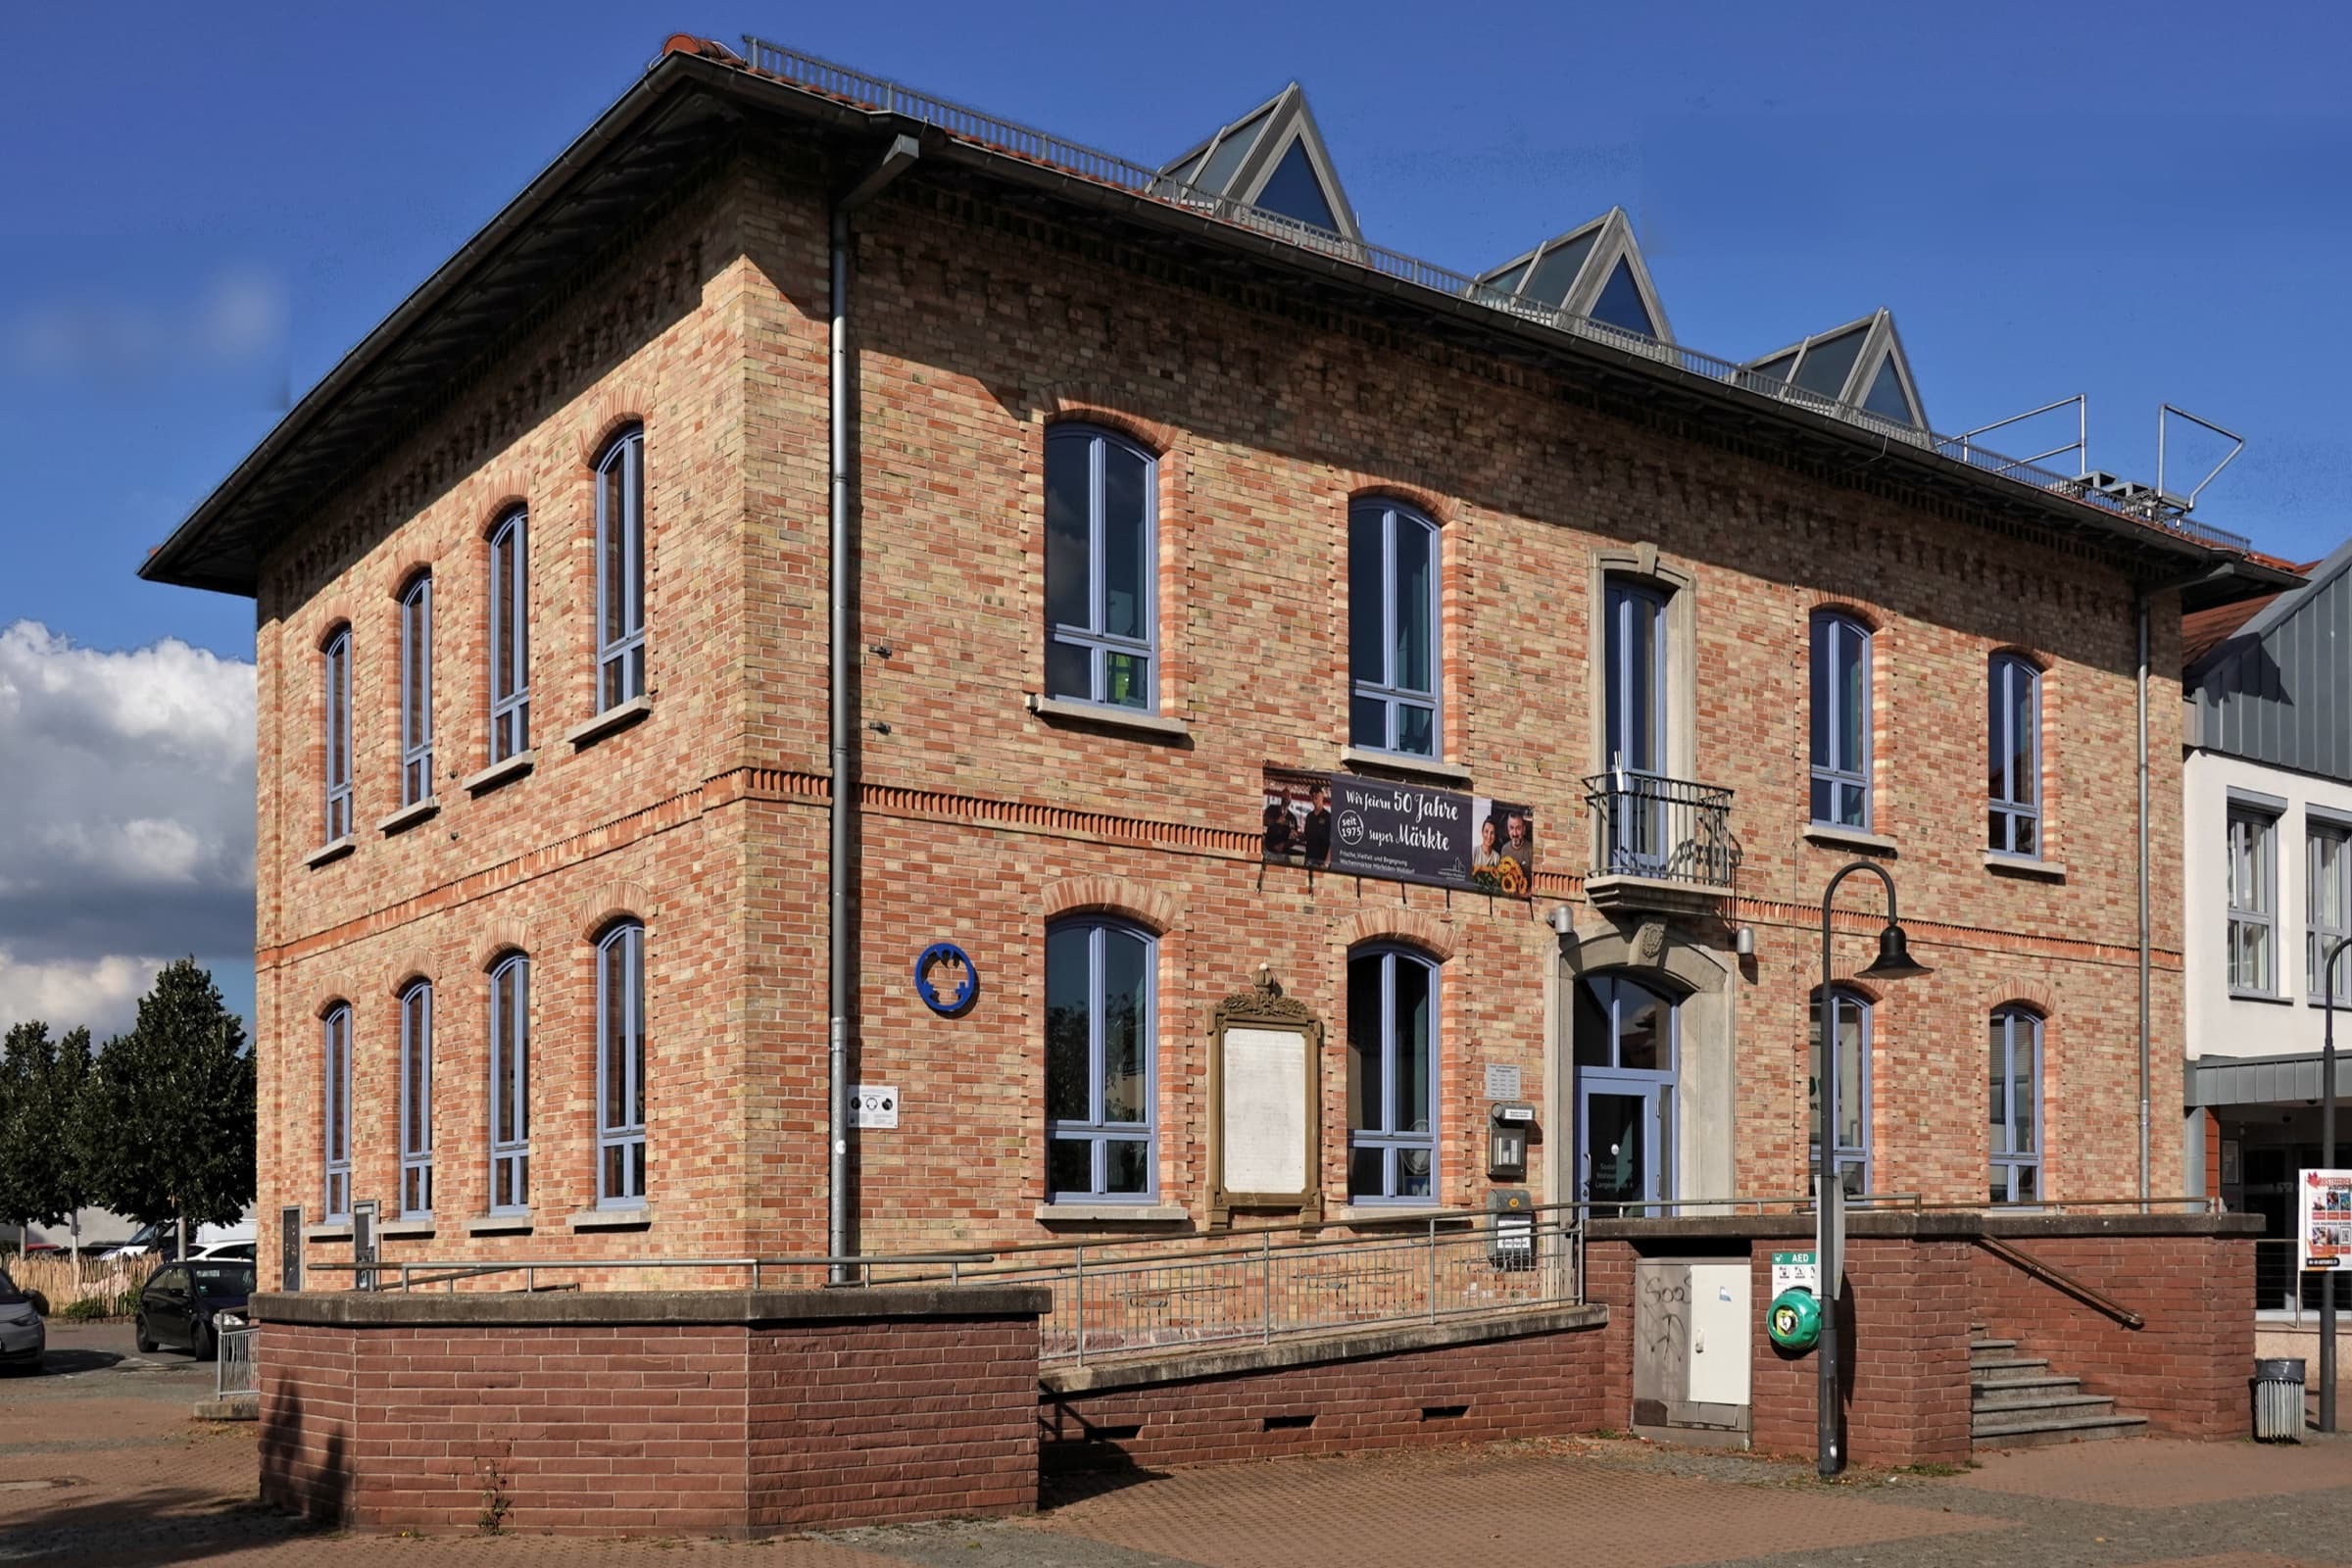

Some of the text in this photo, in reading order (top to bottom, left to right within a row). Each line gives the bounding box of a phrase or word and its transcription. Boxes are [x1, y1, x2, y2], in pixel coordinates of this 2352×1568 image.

[1346, 790, 1458, 823] Wir feiern 50 Jahre
[1342, 816, 1356, 826] seit
[1342, 826, 1361, 837] 1975
[1369, 823, 1450, 851] super Märkte
[1791, 1253, 1809, 1263] AED
